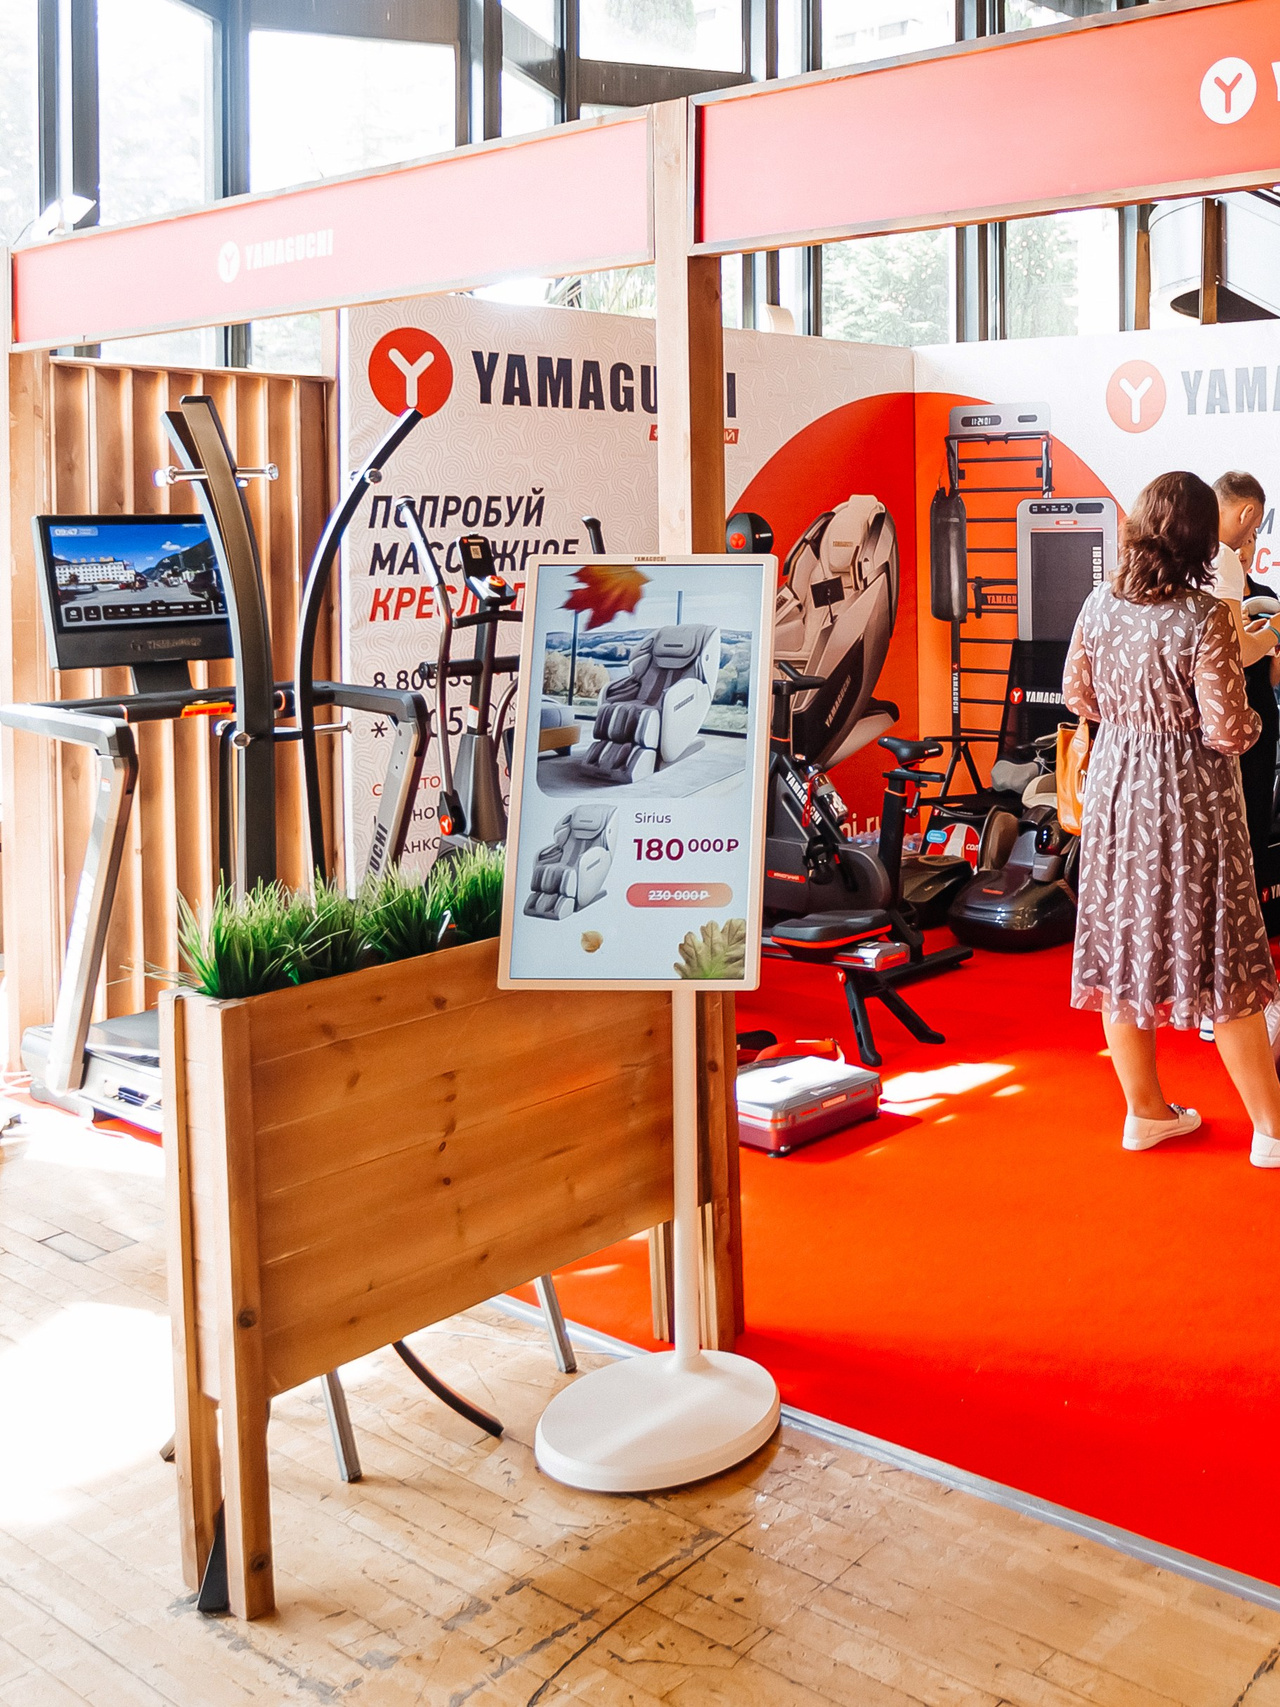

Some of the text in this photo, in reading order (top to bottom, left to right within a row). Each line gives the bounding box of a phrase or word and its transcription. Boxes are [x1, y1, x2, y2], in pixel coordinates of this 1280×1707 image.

[245, 228, 333, 270] YAMAGUCHI
[471, 350, 737, 418] YAMAGUI
[987, 593, 1017, 605] YAMAGU
[634, 812, 672, 824] Sirius
[633, 837, 684, 862] 180
